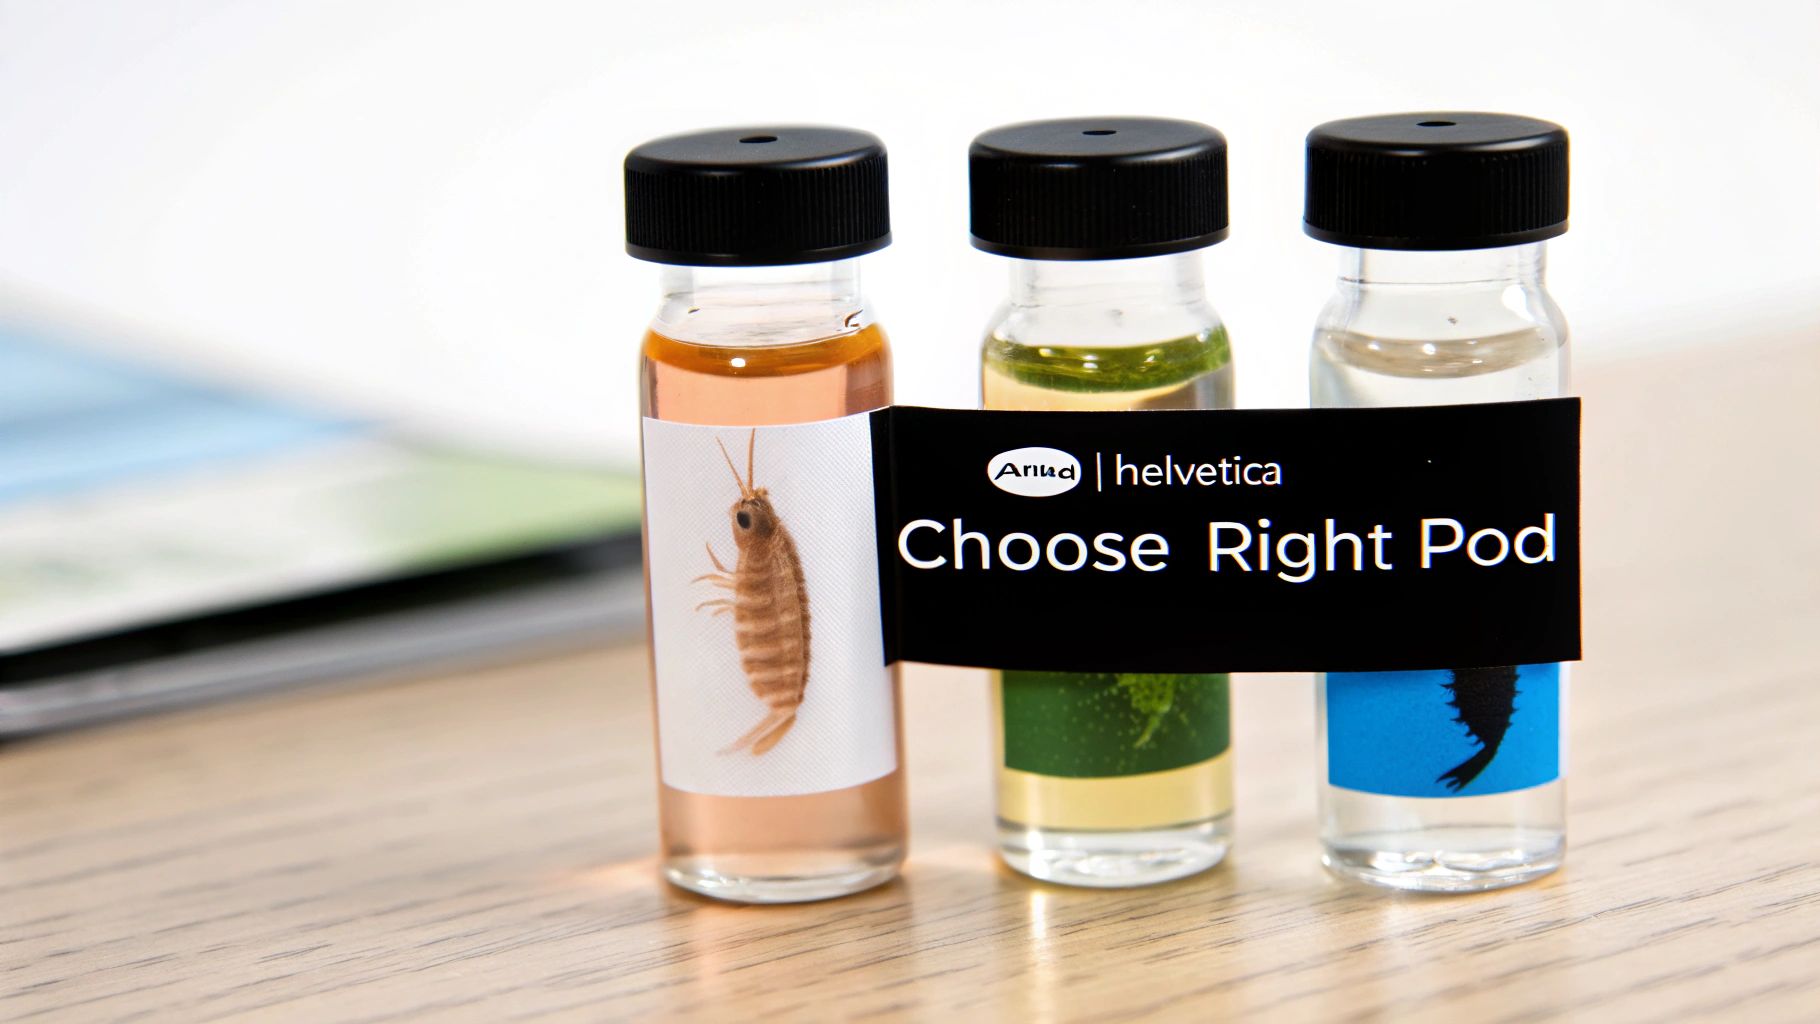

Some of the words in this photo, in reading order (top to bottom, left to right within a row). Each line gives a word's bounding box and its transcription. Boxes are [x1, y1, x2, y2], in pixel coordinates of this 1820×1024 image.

[1116, 453, 1282, 486] helvetica
[897, 518, 1169, 572] Choose
[1209, 518, 1393, 584] Right
[1421, 512, 1555, 569] Pod
